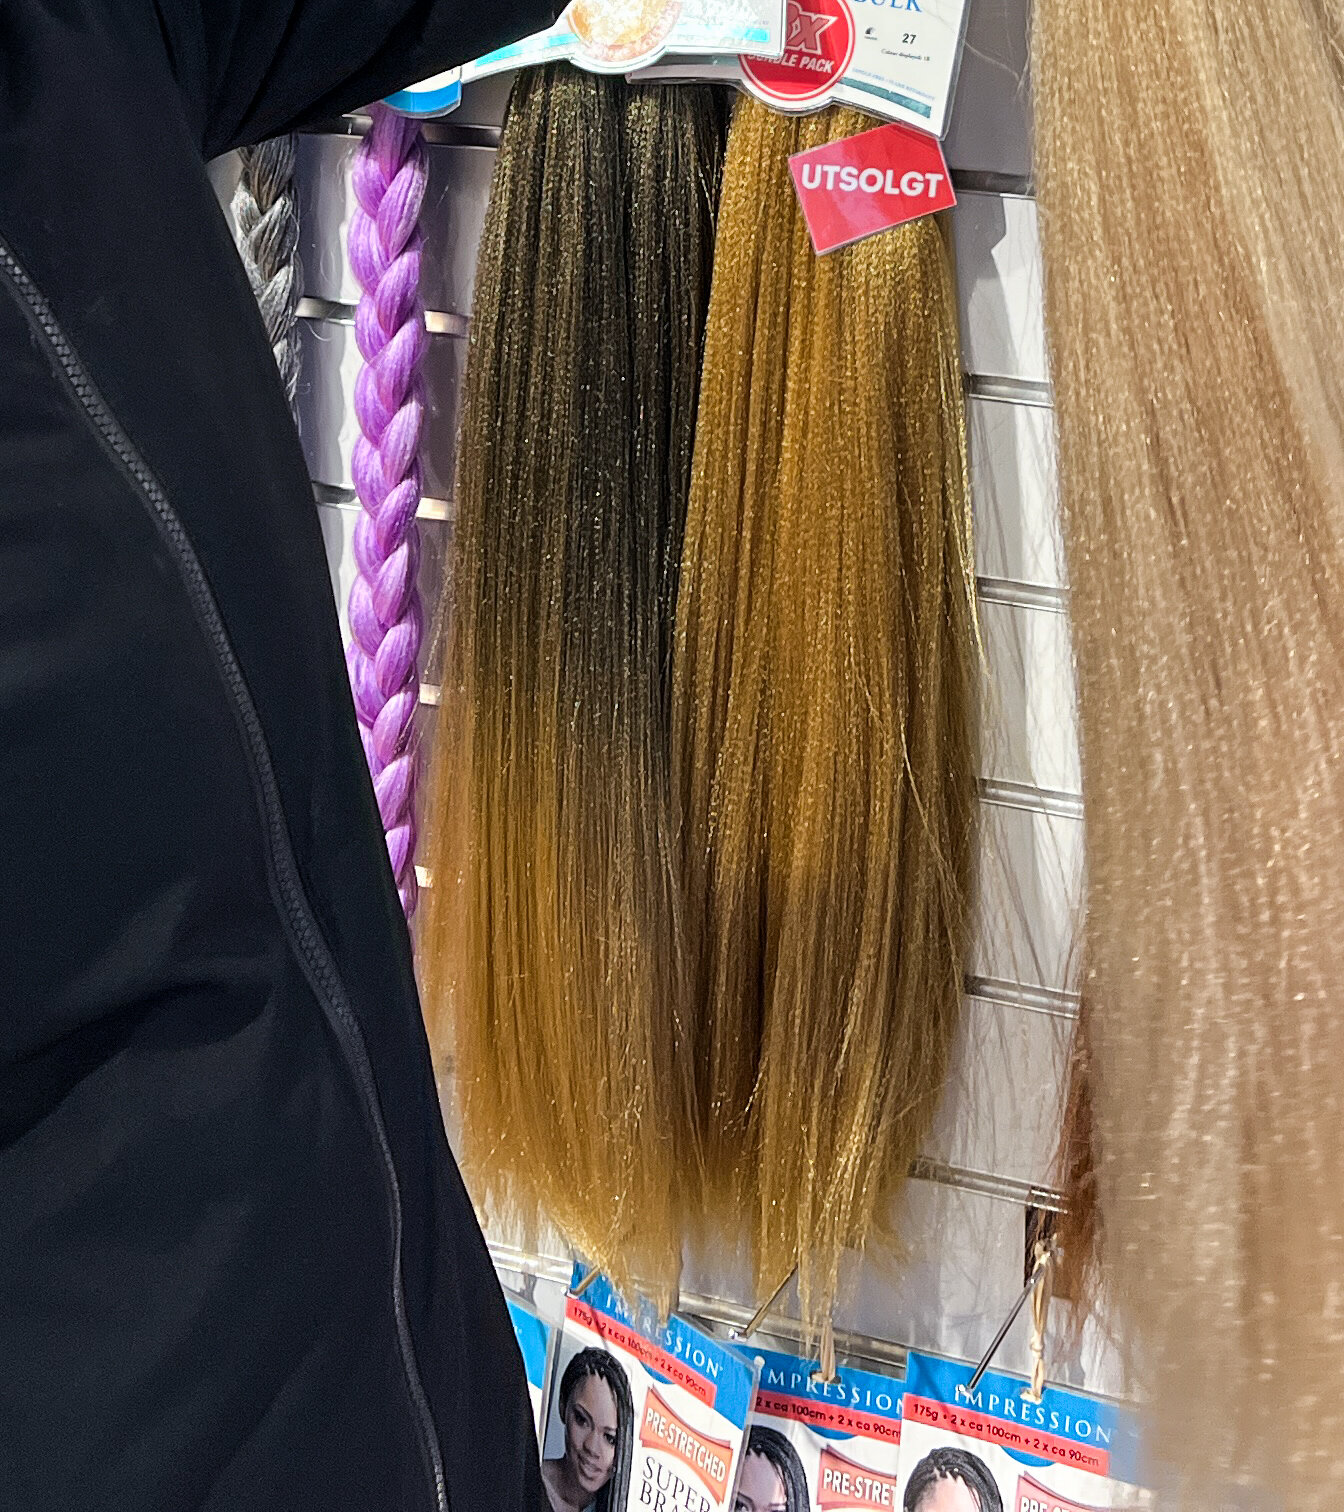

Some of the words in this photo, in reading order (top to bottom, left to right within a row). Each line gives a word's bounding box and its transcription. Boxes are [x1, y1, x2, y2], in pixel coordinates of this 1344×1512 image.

[902, 33, 917, 45] 27
[799, 56, 835, 74] PACK
[801, 163, 944, 198] UTSOLGT
[573, 1306, 594, 1326] 175g
[614, 1332, 626, 1344] ca
[660, 1358, 666, 1368] 2
[673, 1368, 684, 1380] ca
[685, 1373, 706, 1396] 90cm
[773, 1402, 788, 1412] ca
[791, 1403, 826, 1421] 100cm
[837, 1415, 845, 1425] 2
[855, 1422, 870, 1431] ca
[913, 1403, 939, 1421] 175g
[950, 1414, 957, 1424] 2
[969, 1421, 983, 1432] ca
[987, 1424, 1021, 1444] 100cm
[1033, 1438, 1040, 1449] 2
[1052, 1446, 1066, 1457] ca
[1069, 1449, 1099, 1466] 90cm
[954, 1388, 1112, 1444] IMPRESSION
[645, 1407, 726, 1482] PRE-STRETCHED
